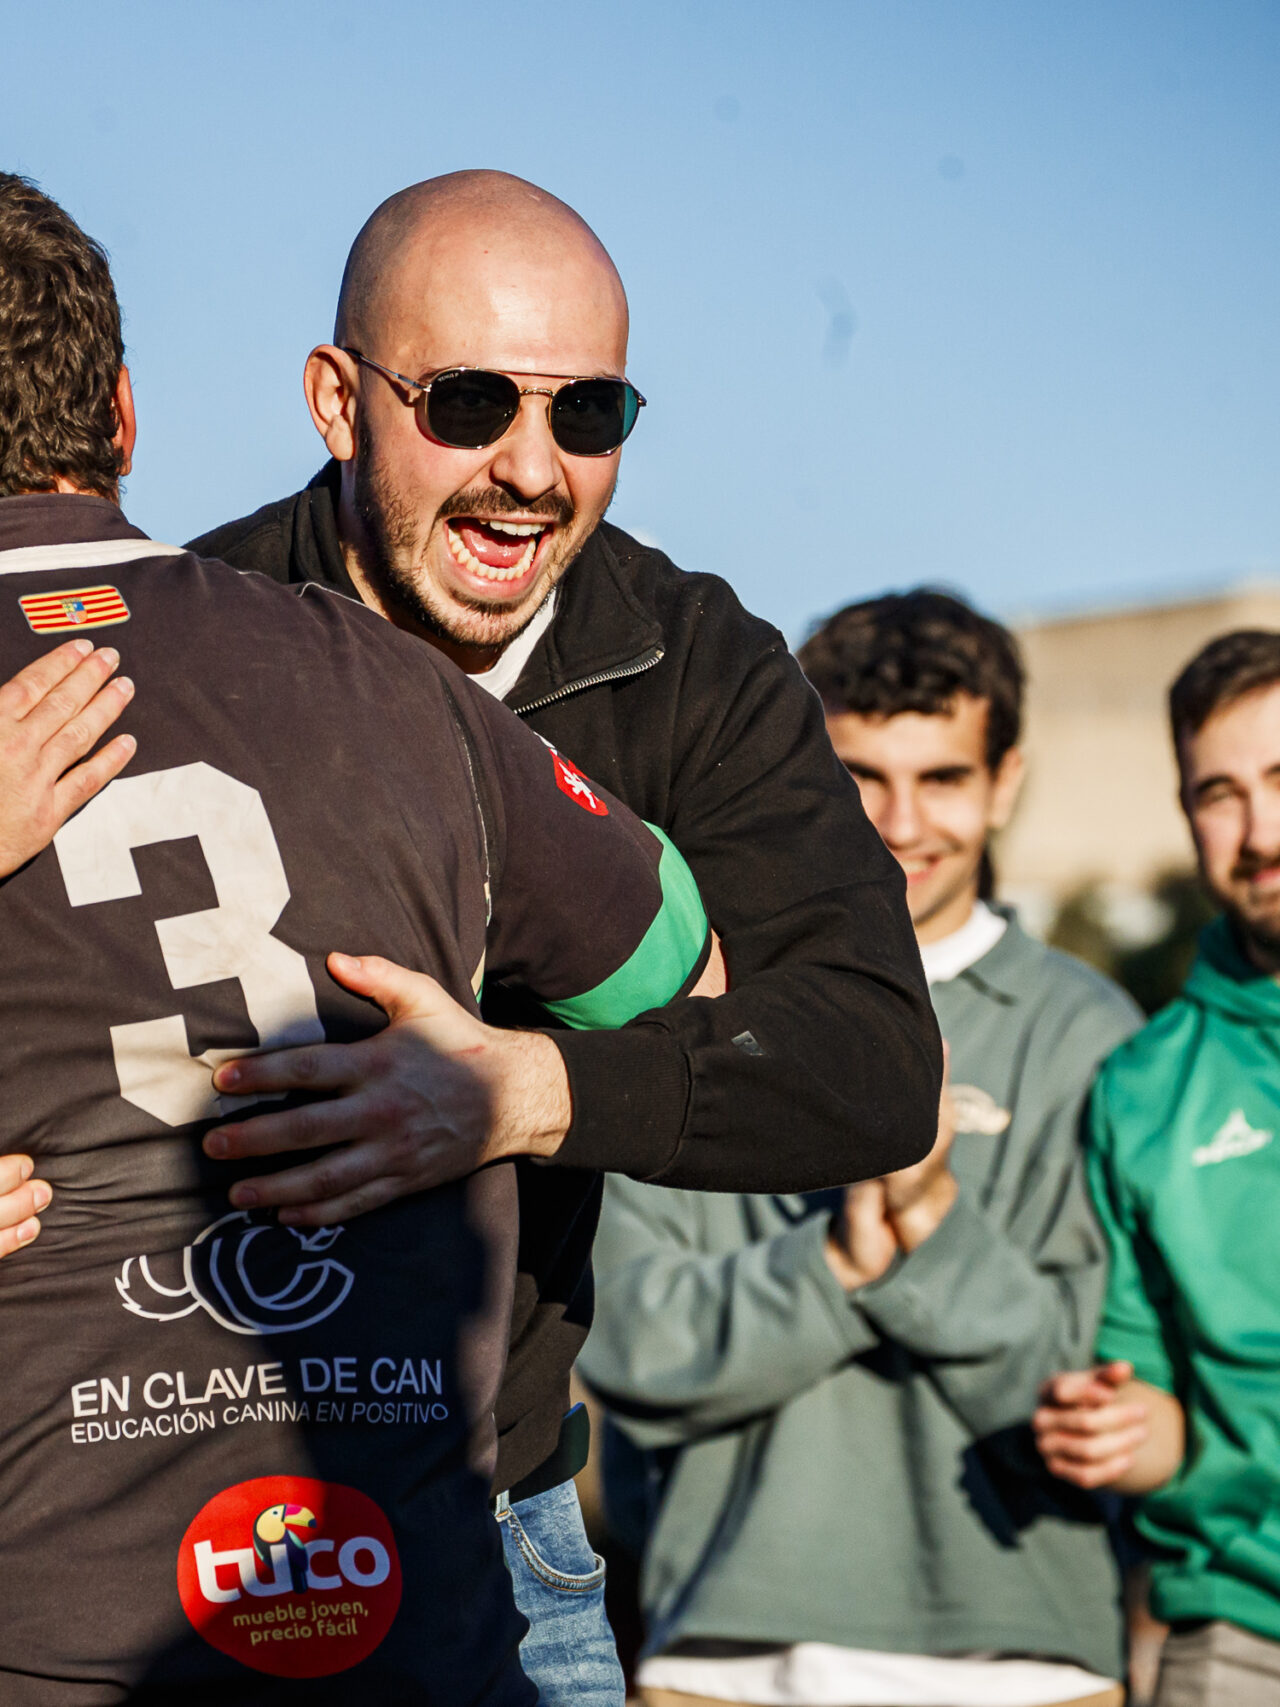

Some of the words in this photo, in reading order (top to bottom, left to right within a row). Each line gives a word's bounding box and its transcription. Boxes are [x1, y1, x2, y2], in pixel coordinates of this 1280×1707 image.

[53, 761, 325, 1127] 3
[71, 1376, 130, 1417] EN
[143, 1362, 287, 1409] CLAVE
[300, 1357, 357, 1393] DE
[370, 1357, 442, 1395] CAN
[71, 1409, 216, 1444] EDUCACIÓN
[222, 1401, 310, 1425] CANINA
[315, 1401, 343, 1422] EN
[351, 1401, 449, 1424] POSITIVO
[193, 1536, 391, 1603] tuco
[233, 1603, 307, 1627] mueble
[310, 1601, 369, 1621] joven,
[250, 1624, 313, 1646] precio
[317, 1619, 358, 1637] fácil
